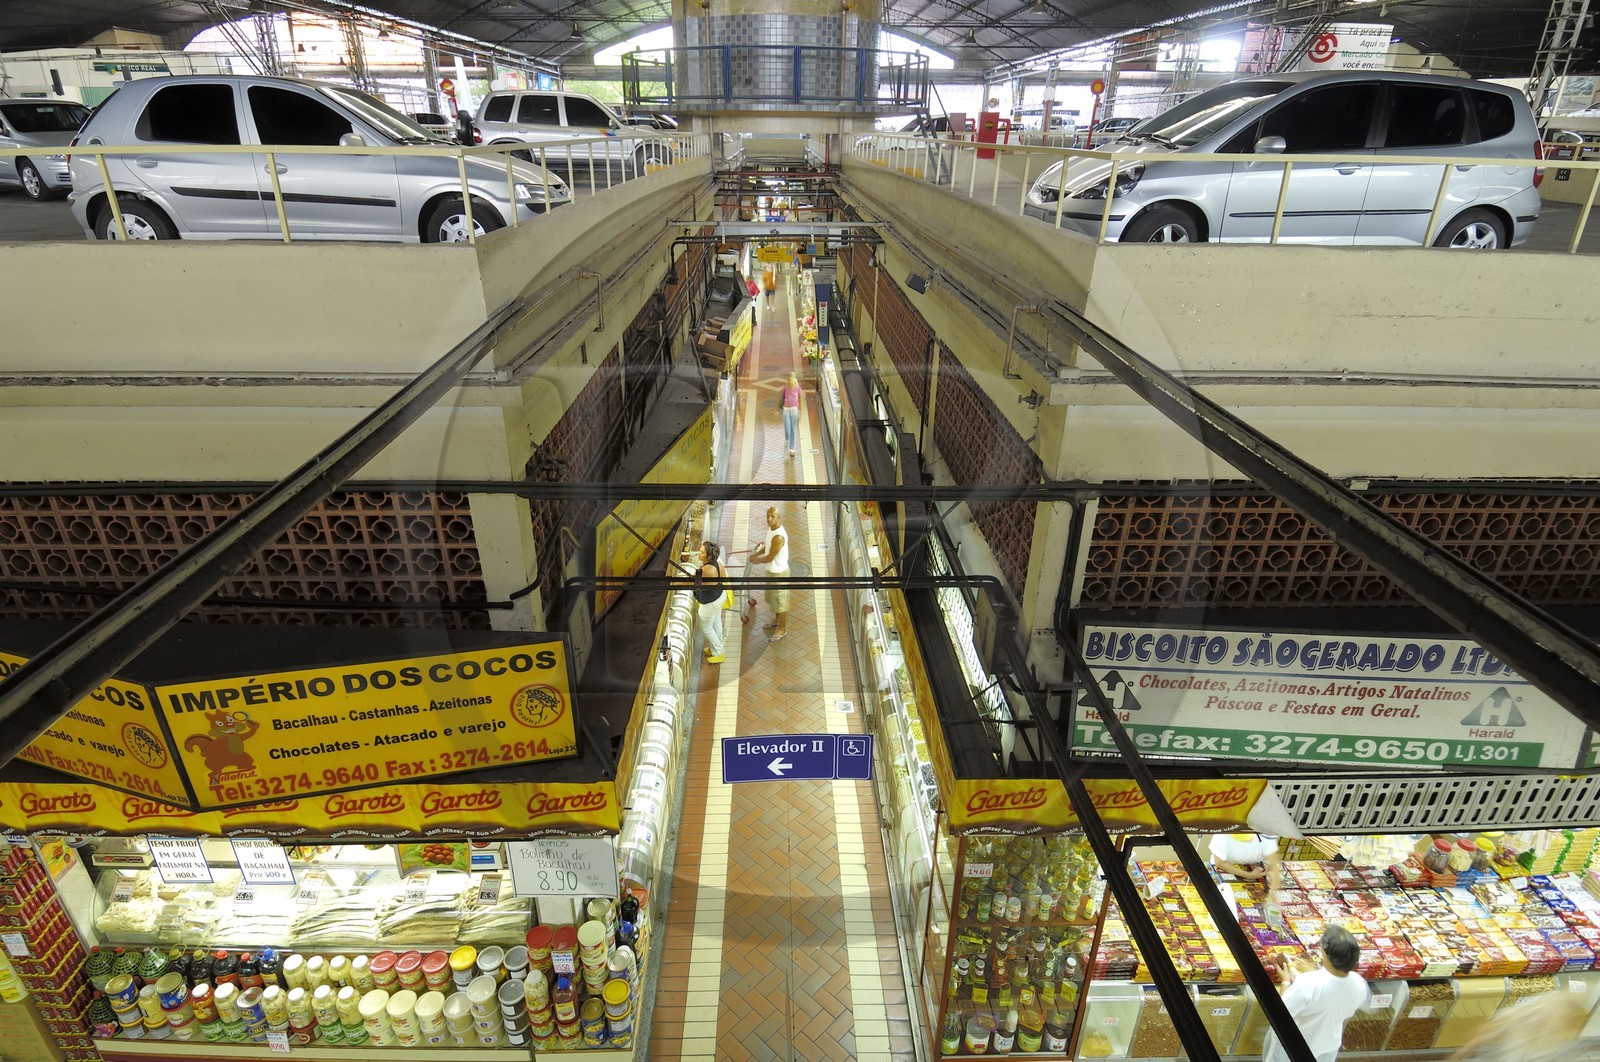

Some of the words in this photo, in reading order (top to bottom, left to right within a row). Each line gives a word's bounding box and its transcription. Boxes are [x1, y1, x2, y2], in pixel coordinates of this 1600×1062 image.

[1360, 40, 1377, 48] Aqui
[1341, 50, 1373, 58] Mercado
[1342, 60, 1360, 69] você
[1085, 630, 1229, 665] BISCOITO
[1450, 644, 1521, 679] LTD
[169, 677, 335, 714] IMPÉRIO
[342, 666, 423, 694] DOS
[428, 650, 558, 683] COCOS
[1320, 680, 1387, 701] Artigos
[1389, 684, 1471, 703] Natalinos
[272, 714, 338, 732] Bacalhau
[349, 703, 419, 722] Castanhas
[429, 693, 493, 712] Azeitonas
[1204, 694, 1262, 712] Páscoa
[1268, 702, 1278, 712] e
[1281, 699, 1335, 717] Festas
[1341, 705, 1364, 717] em
[1371, 702, 1421, 719] Geral.
[65, 710, 106, 728] zeitonas
[1085, 710, 1131, 722] Hald
[269, 736, 360, 760] Chocolates
[374, 728, 438, 748] Atacado
[443, 727, 453, 737] e
[458, 719, 506, 737] varejo
[1468, 727, 1516, 739] Harald
[78, 736, 86, 746] e
[90, 740, 126, 759] varejo
[737, 739, 807, 756] Elevador
[812, 740, 825, 752] II
[1244, 734, 1449, 761] 3274-9650
[20, 792, 97, 818] Garoto
[323, 791, 406, 820] Garoto
[419, 789, 503, 820] Garoto
[526, 790, 608, 820] Garoto
[966, 785, 1048, 817] Garoto
[1170, 786, 1250, 815] Garoto
[150, 840, 174, 848] TEMOS
[176, 840, 198, 848] FRIOS
[233, 841, 252, 849] TEMOS
[536, 838, 570, 848] Temos
[172, 851, 197, 859] GERAL
[254, 852, 265, 860] DE
[519, 847, 564, 860] Bolinho
[572, 848, 585, 861] de
[158, 861, 193, 870] FATIAMOS
[195, 861, 207, 869] NA
[244, 862, 286, 870] BACALHAU
[536, 858, 591, 871] Bacalhau
